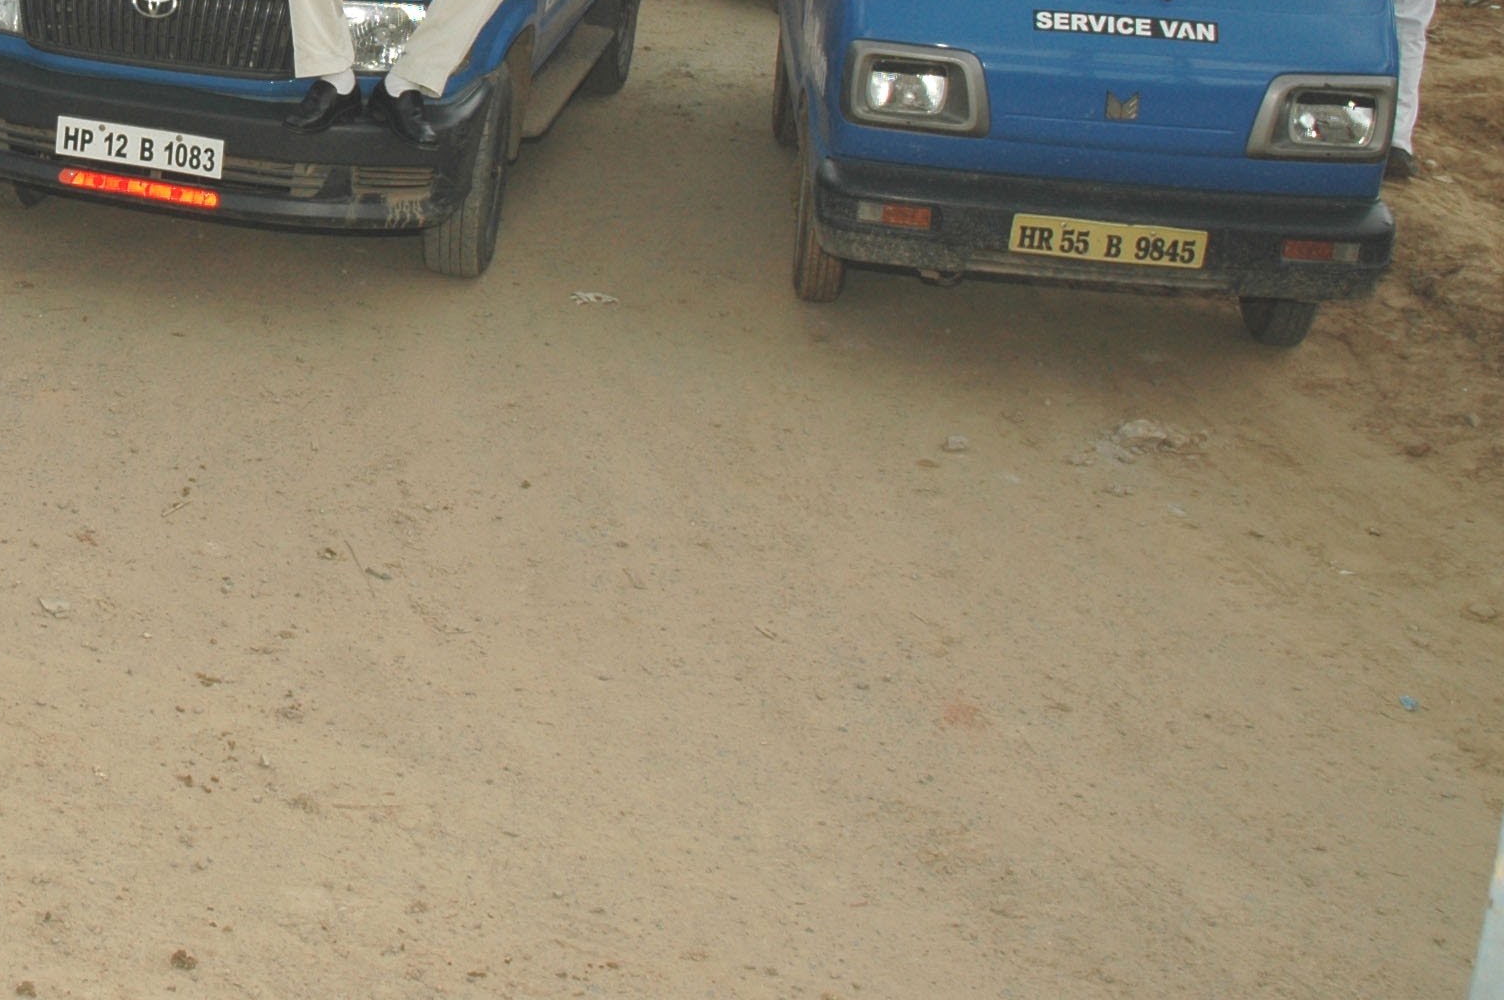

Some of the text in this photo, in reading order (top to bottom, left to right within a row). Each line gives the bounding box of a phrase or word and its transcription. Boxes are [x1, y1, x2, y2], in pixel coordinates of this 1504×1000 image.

[1035, 11, 1215, 42] SERVICE VAN
[63, 126, 215, 172] HP 12 B 1083
[1017, 225, 1196, 264] HR 55 B 9845
